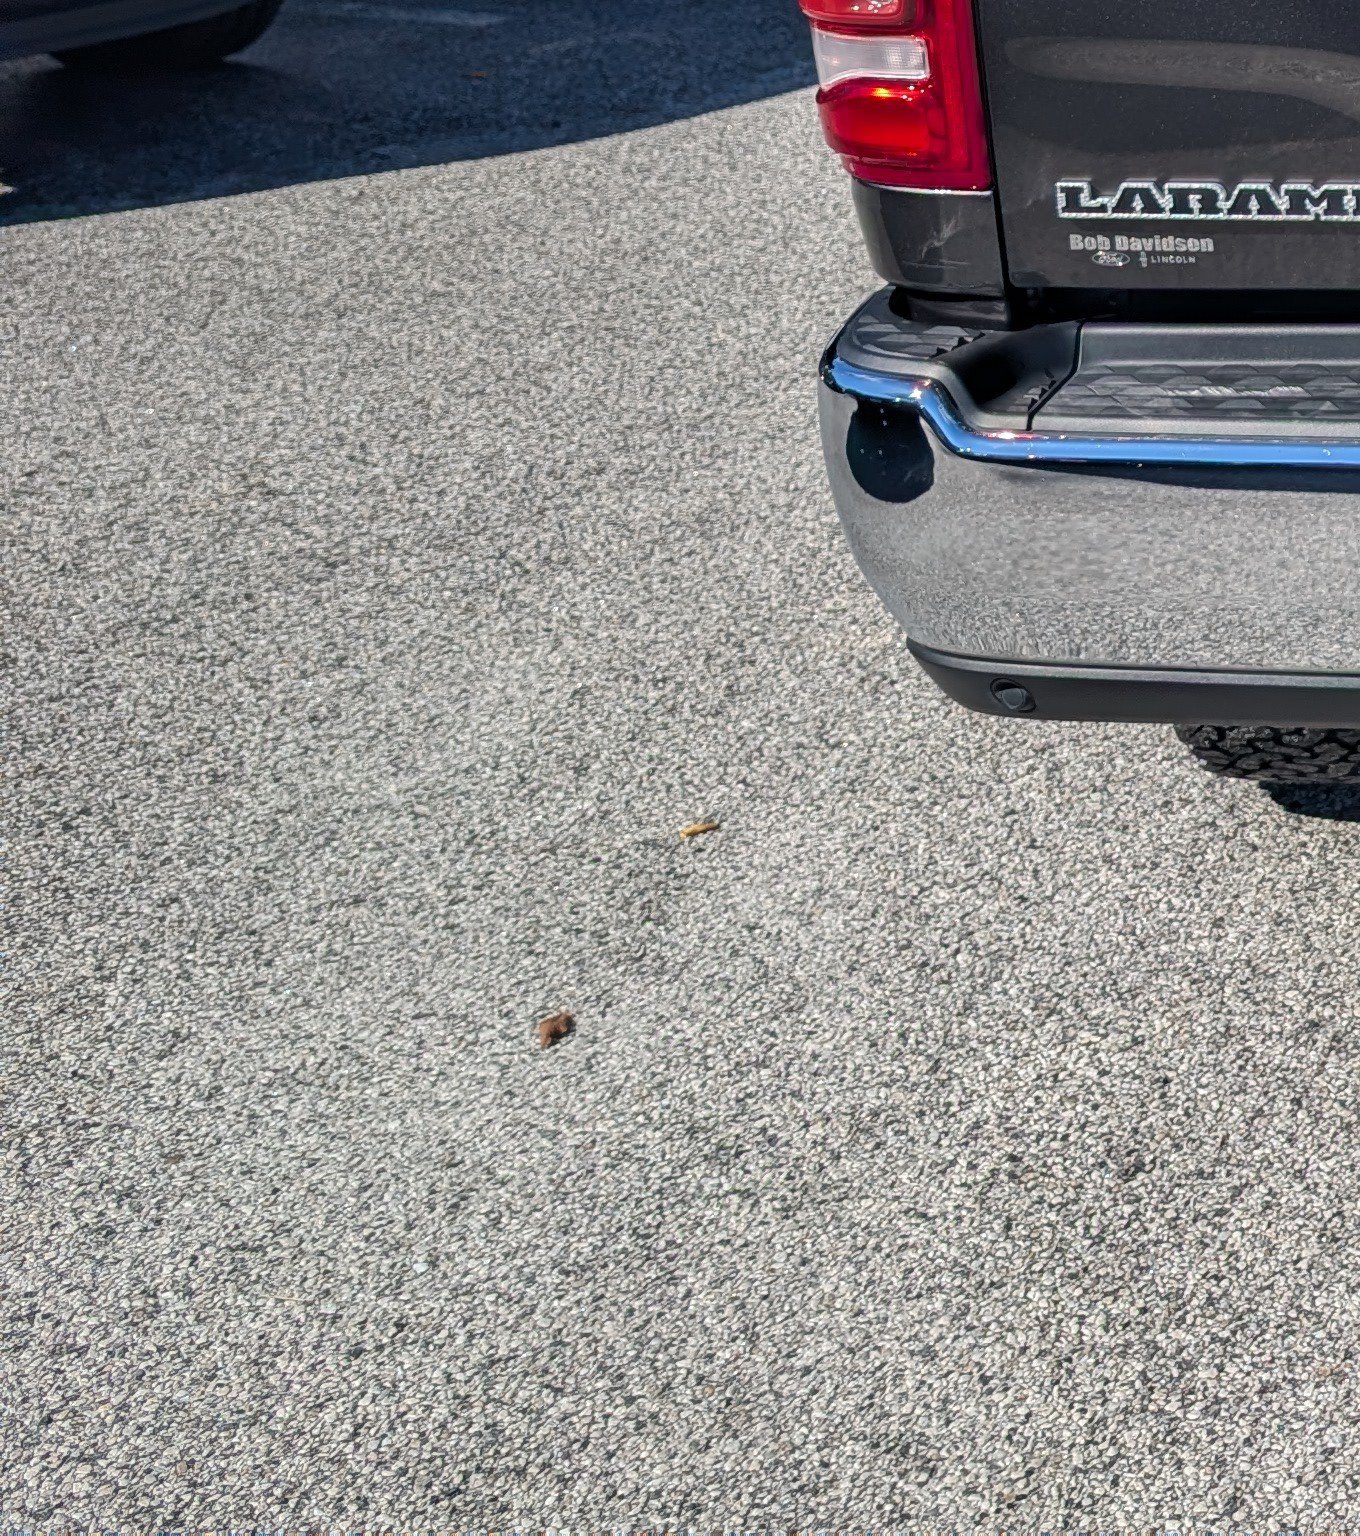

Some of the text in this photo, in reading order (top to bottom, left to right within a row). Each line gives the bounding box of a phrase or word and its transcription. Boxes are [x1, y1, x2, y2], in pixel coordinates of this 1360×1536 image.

[1069, 234, 1215, 252] Bob Davidson
[1151, 255, 1196, 264] LINCOLN
